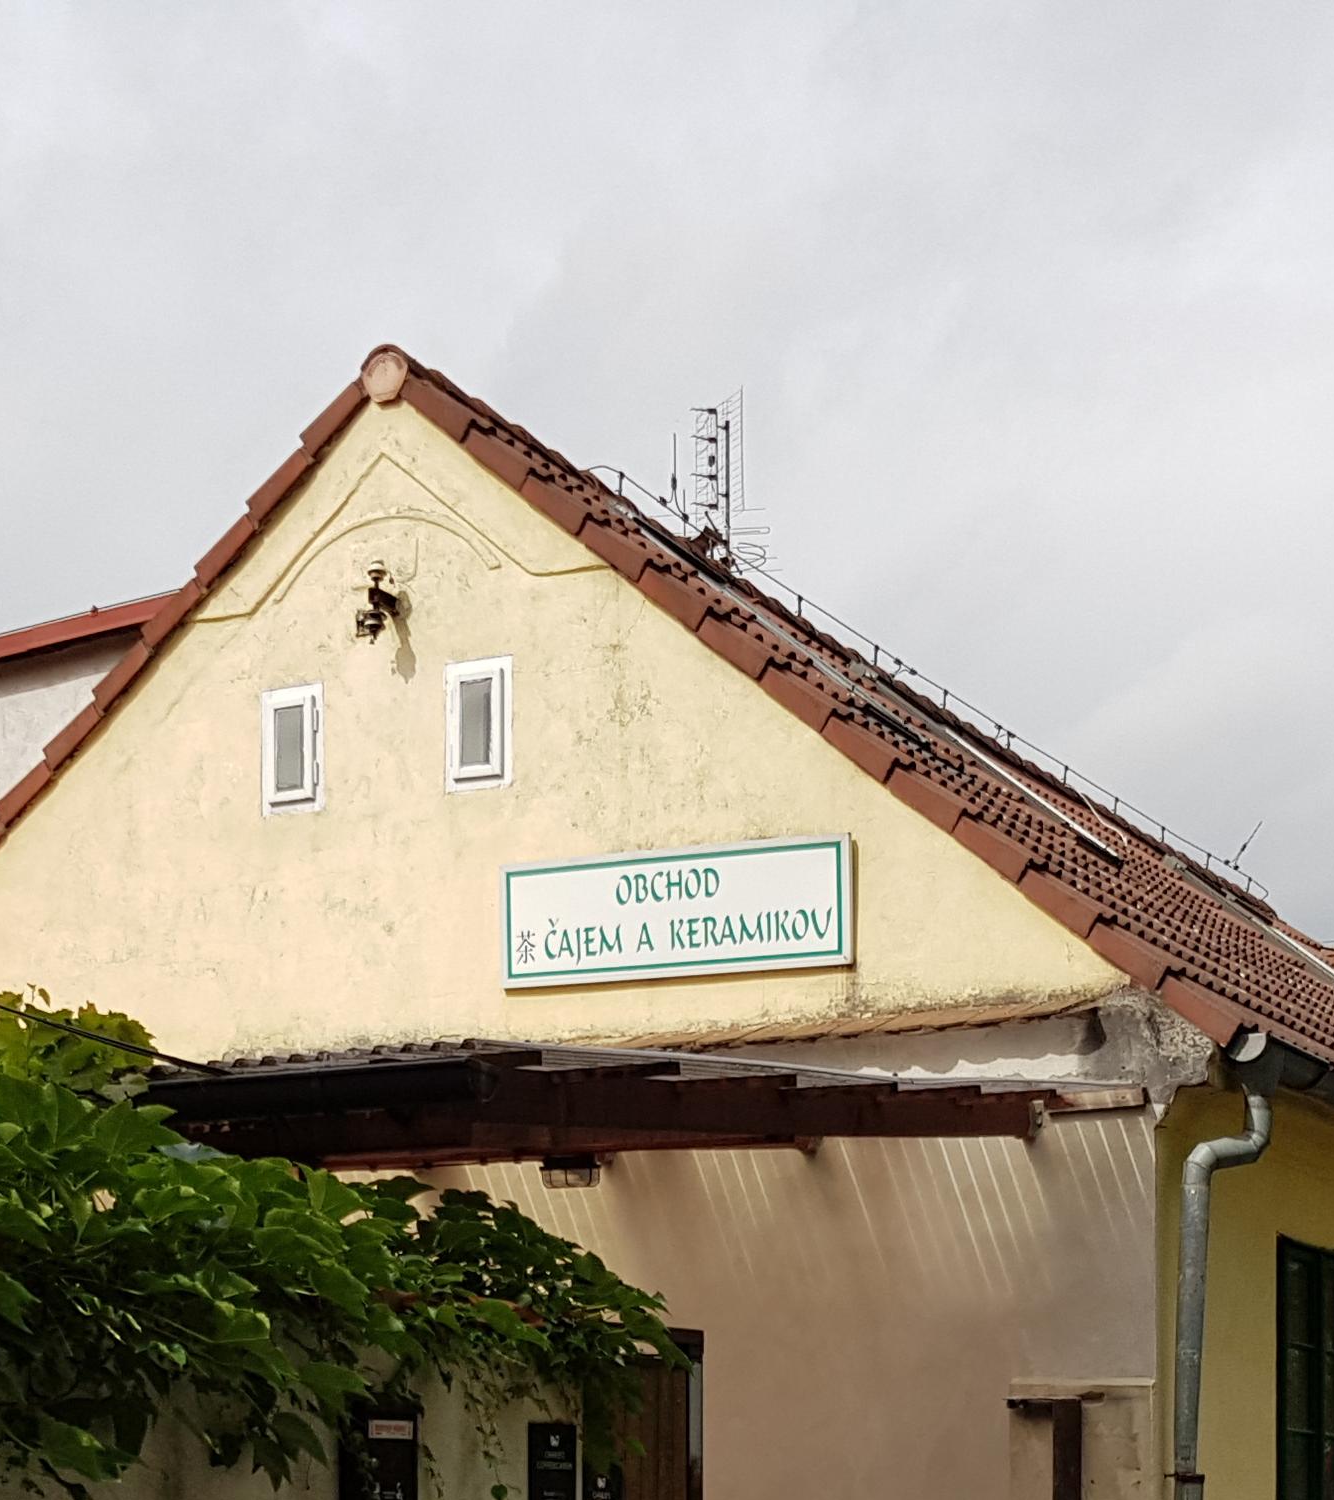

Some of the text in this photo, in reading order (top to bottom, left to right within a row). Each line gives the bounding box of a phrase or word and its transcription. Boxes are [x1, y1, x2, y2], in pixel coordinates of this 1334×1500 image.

[615, 867, 721, 905] OBCHOD
[516, 931, 536, 964] 茶
[544, 907, 833, 965] ČAJEM A KERAMIKOV
